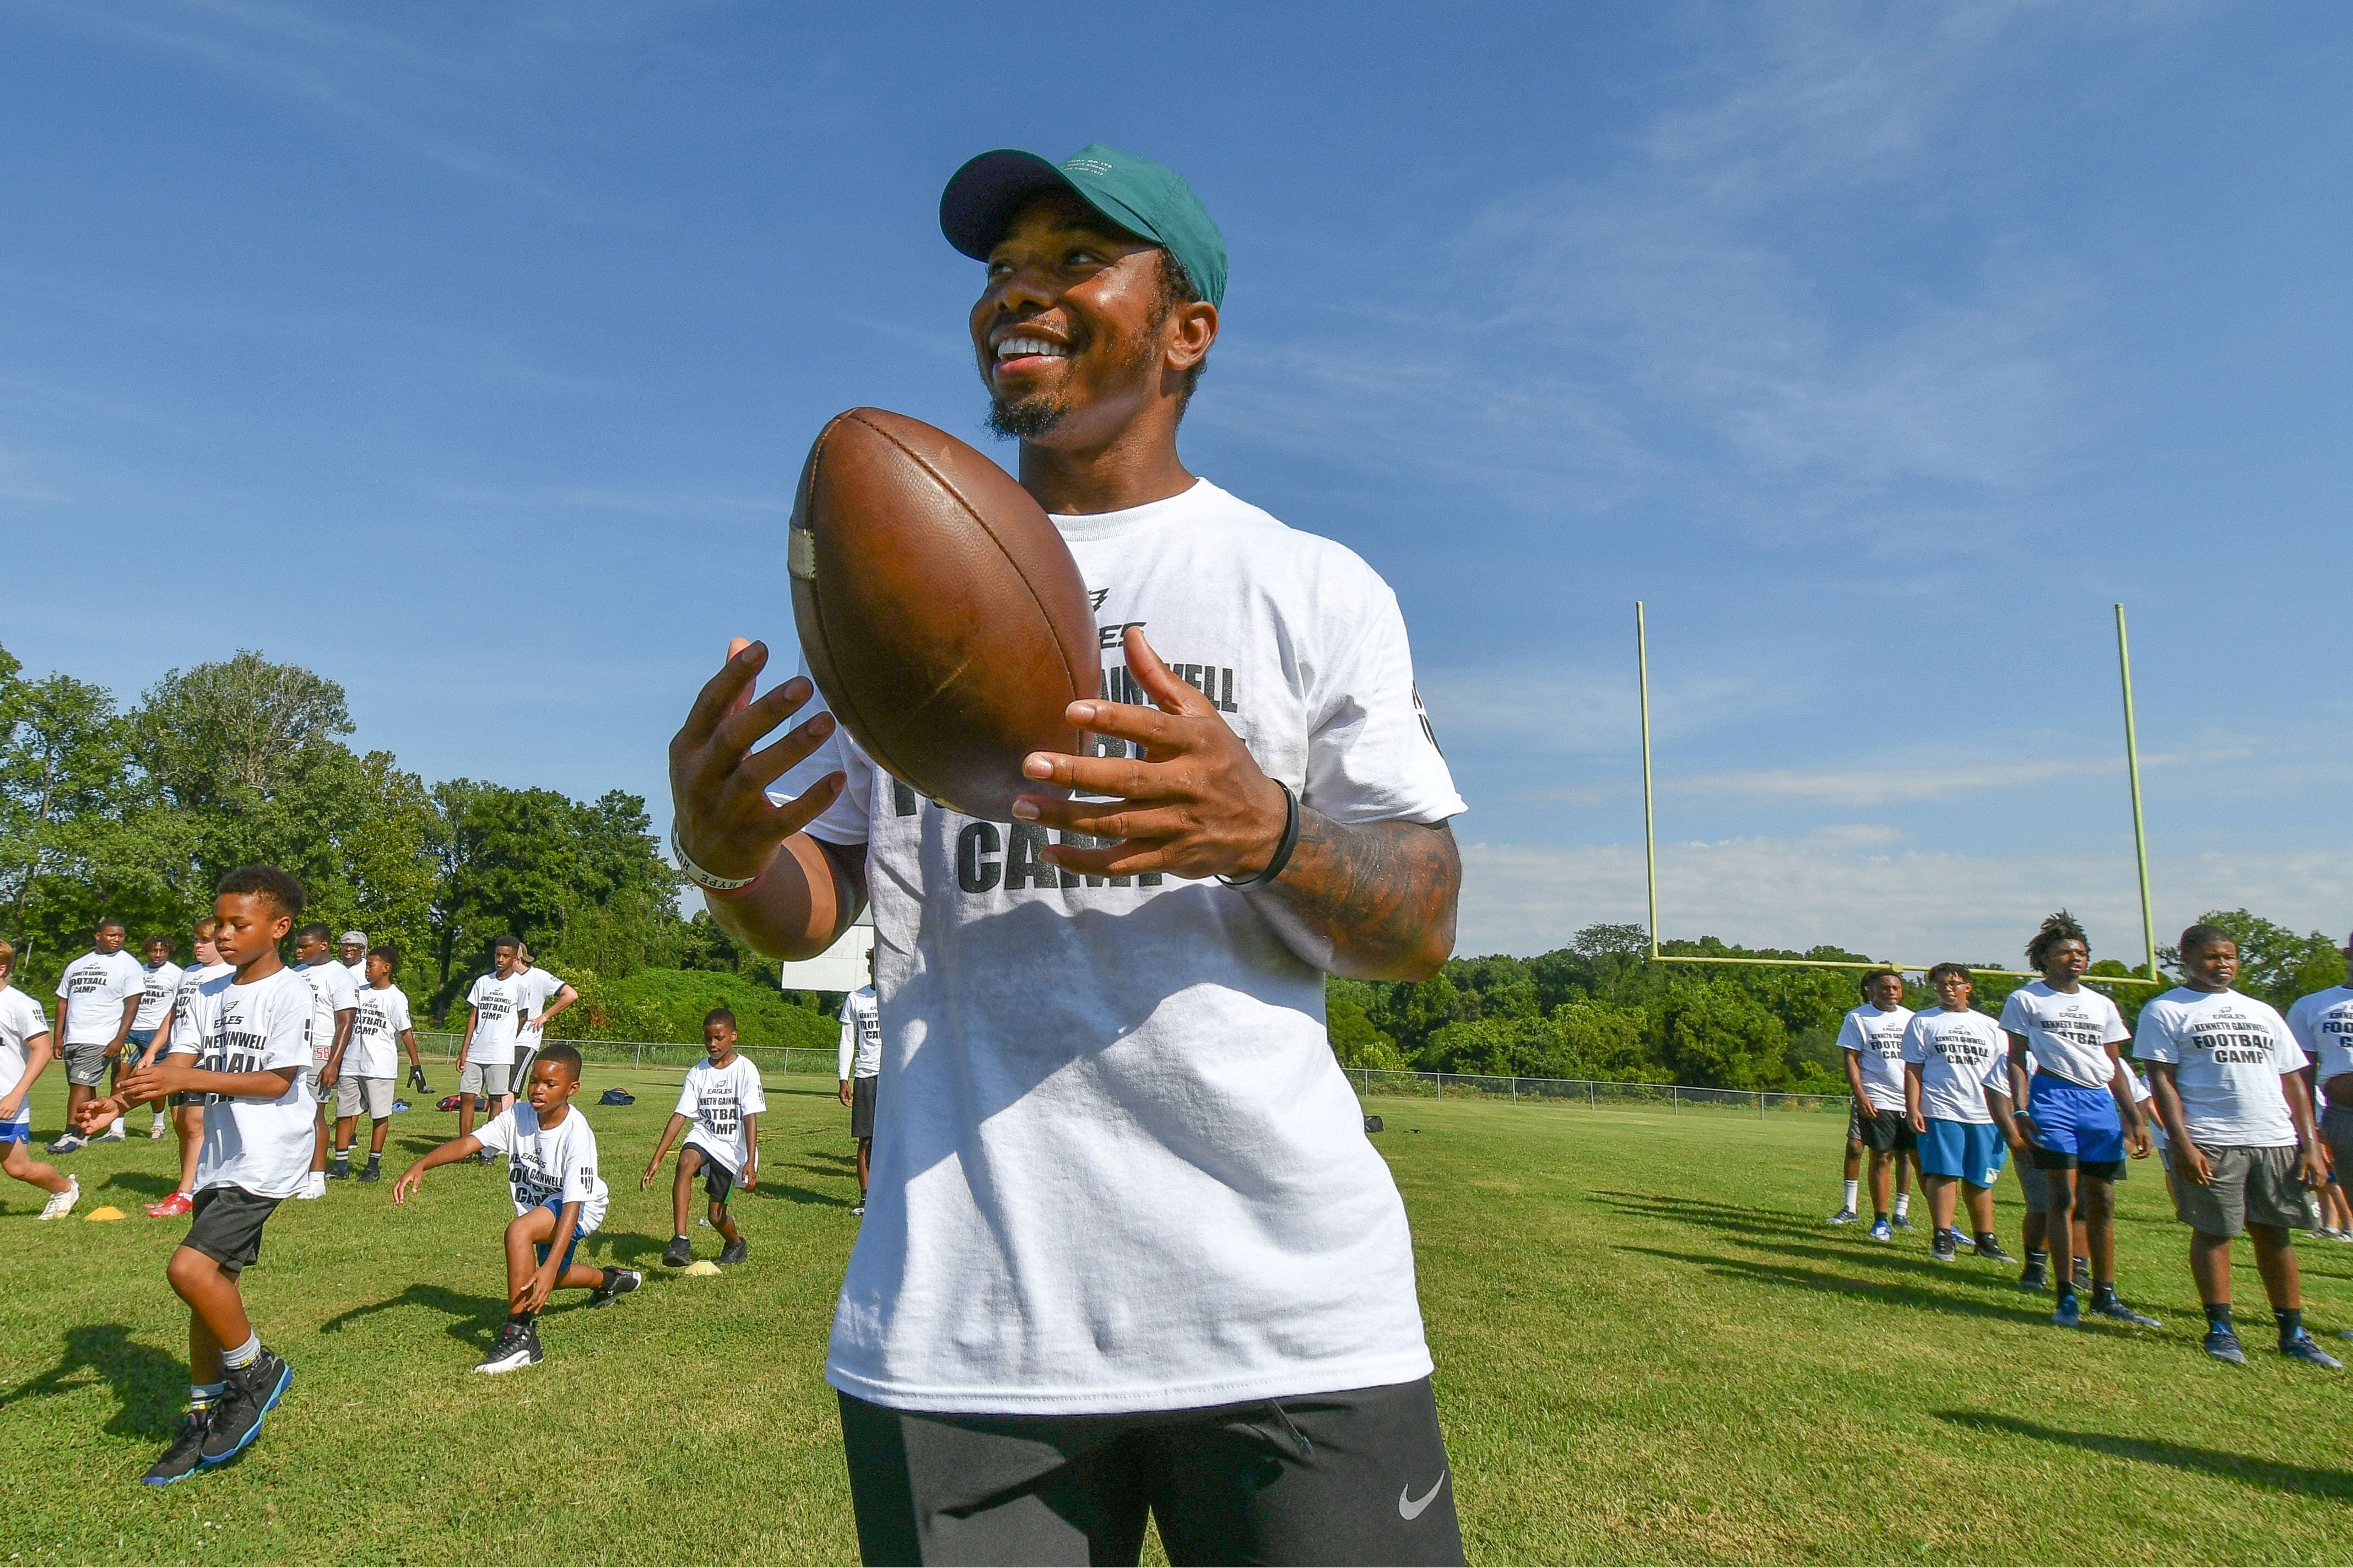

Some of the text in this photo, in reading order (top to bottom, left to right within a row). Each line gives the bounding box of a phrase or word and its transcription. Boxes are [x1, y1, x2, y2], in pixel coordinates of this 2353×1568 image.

[700, 874, 739, 888] HYPE
[860, 1021, 878, 1030] FOOT
[2194, 1022, 2231, 1032] KENNETH
[1870, 1041, 1902, 1050] FOOTB
[2192, 1034, 2274, 1051] FOOTBALL
[316, 1048, 329, 1059] 58
[1934, 1044, 1989, 1057] FOOTBALL
[1947, 1055, 1979, 1065] CAMP
[2215, 1050, 2264, 1064] CAMP
